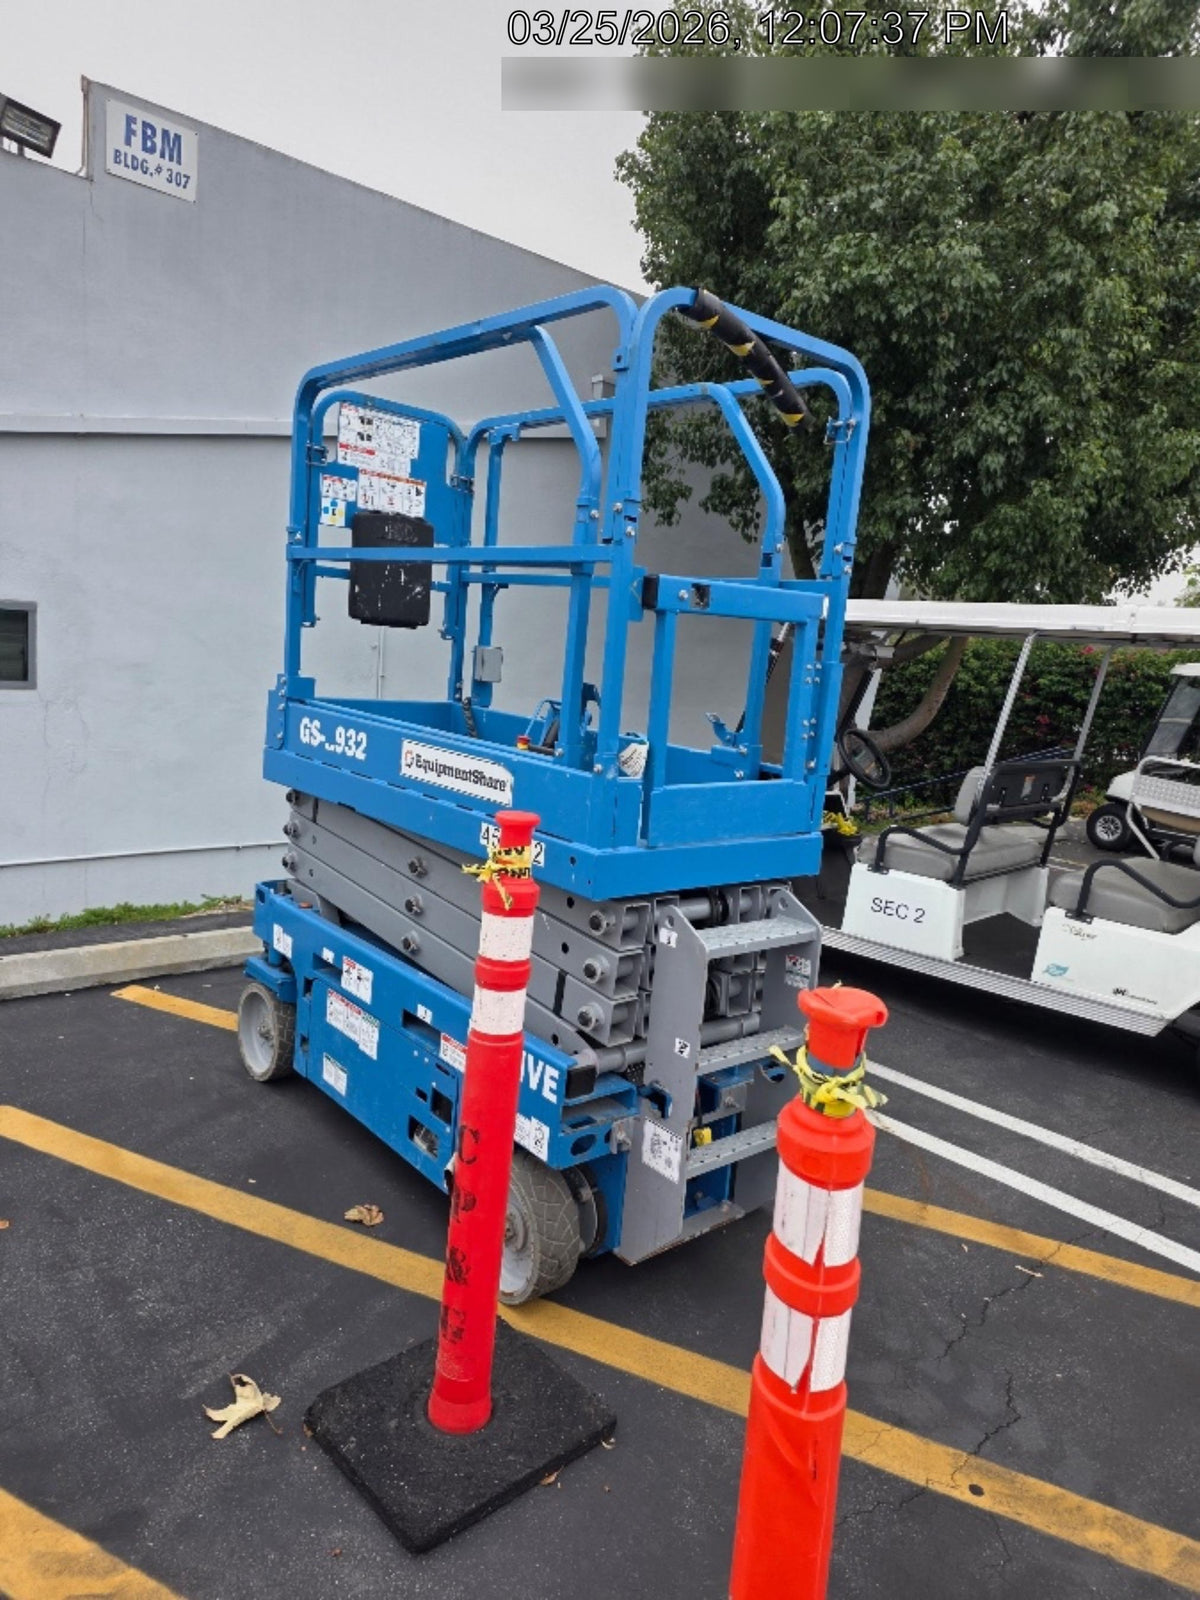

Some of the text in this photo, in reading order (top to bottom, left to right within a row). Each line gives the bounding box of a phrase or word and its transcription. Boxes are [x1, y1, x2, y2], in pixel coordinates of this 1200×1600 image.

[124, 113, 182, 166] FBM
[166, 168, 191, 190] 307
[415, 752, 507, 792] EquipmentShare
[871, 897, 926, 924] SEC 2
